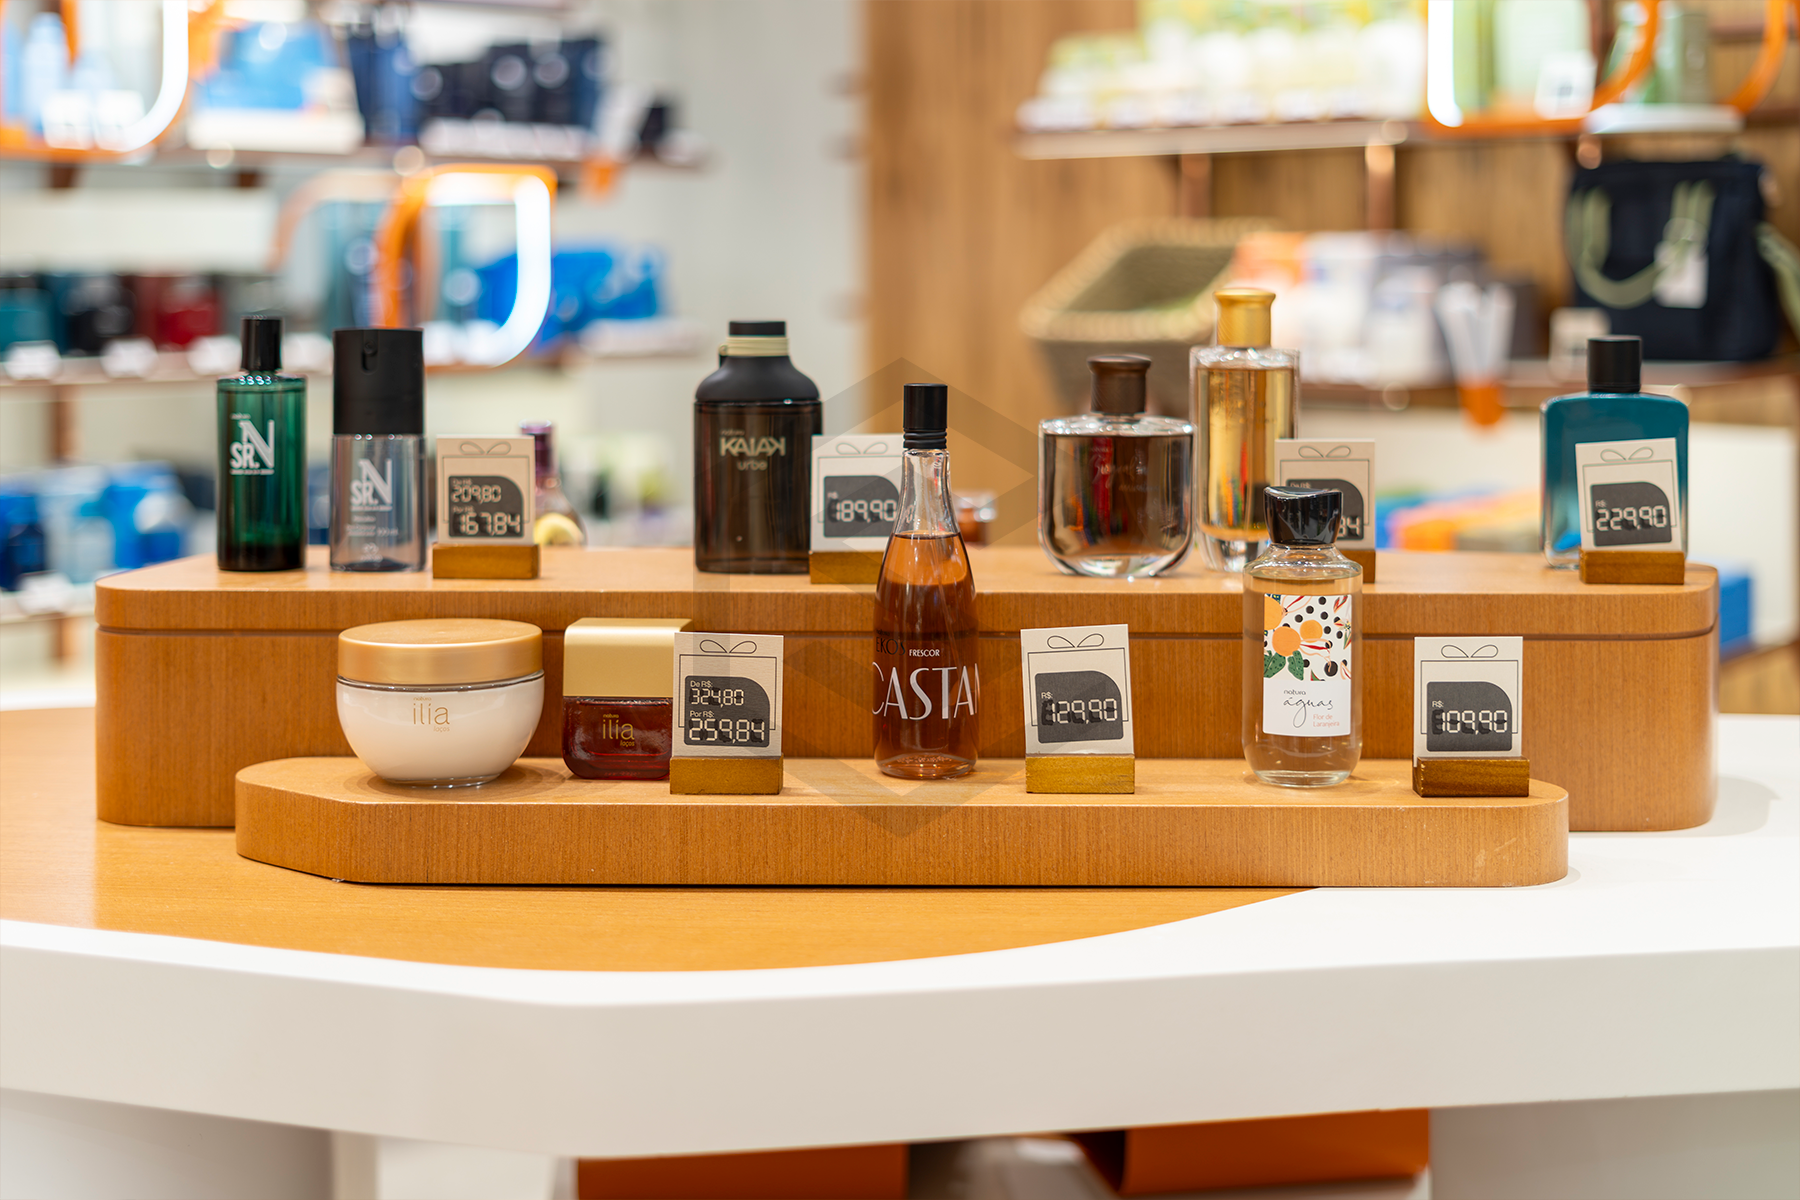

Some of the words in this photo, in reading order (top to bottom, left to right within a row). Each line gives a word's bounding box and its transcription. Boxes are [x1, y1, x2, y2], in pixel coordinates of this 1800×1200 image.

[720, 436, 785, 456] KAIAK
[737, 460, 768, 470] urbe
[451, 485, 501, 504] 209,80
[836, 500, 897, 523] 189,90
[1596, 505, 1667, 531] 229,90
[460, 512, 520, 536] 167,84
[876, 636, 906, 656] EKOS
[909, 649, 940, 658] FRESCOR
[691, 688, 744, 708] 324,80
[1051, 698, 1118, 724] 129,90
[1283, 697, 1333, 728] águas
[1442, 710, 1508, 735] 109,90
[689, 718, 765, 744] 259,84
